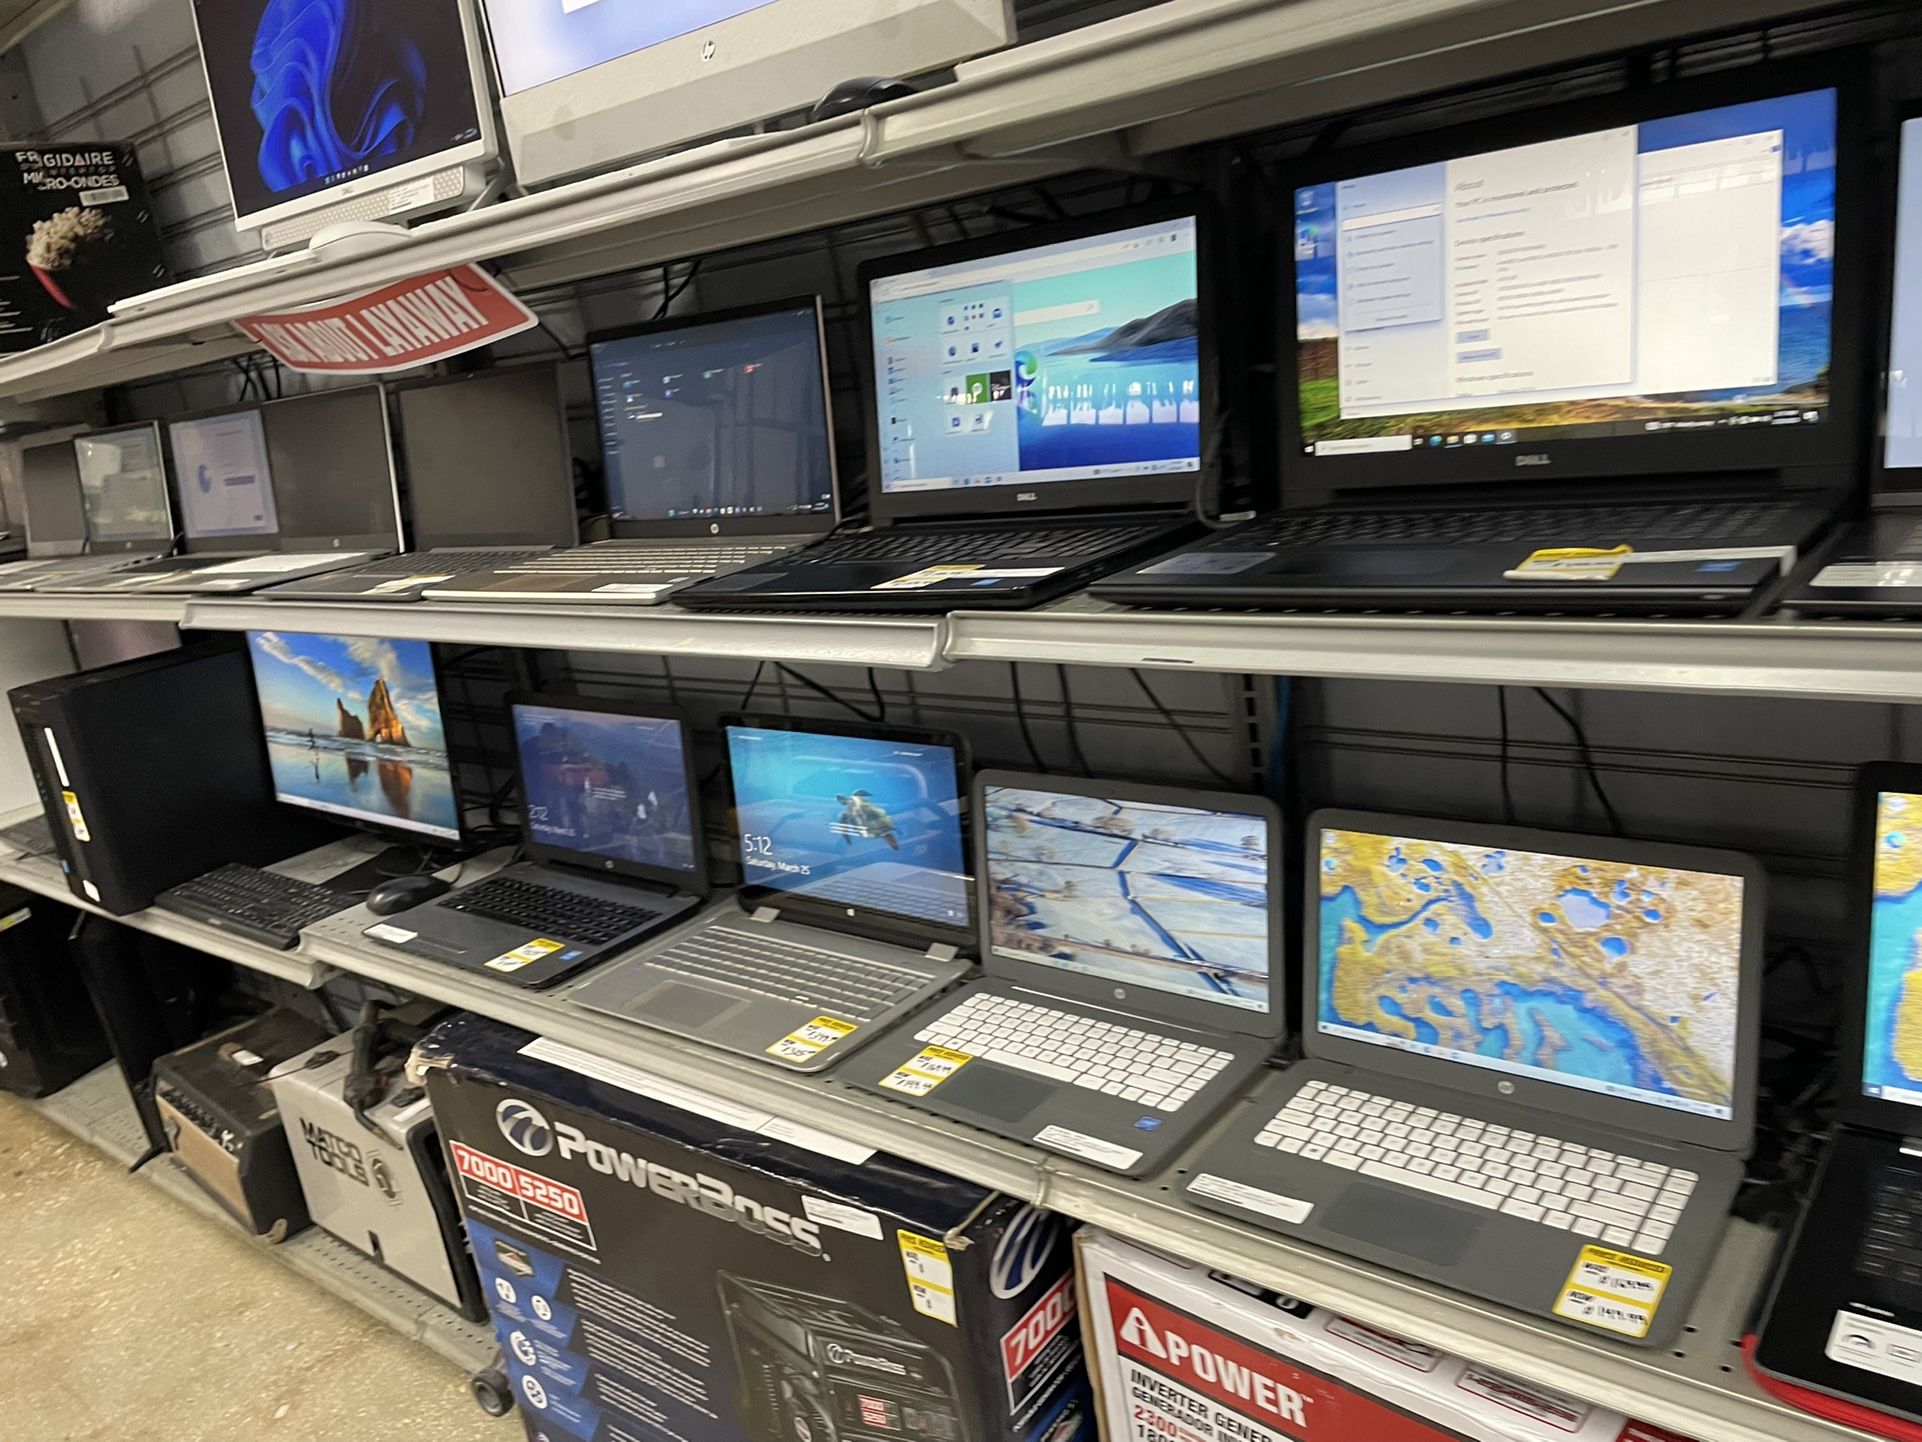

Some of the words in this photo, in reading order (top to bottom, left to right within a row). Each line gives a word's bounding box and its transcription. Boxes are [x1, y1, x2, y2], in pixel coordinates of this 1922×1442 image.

[345, 275, 489, 358] LAYAWAY
[743, 832, 773, 856] 5:12
[299, 1116, 363, 1165] MATCO
[456, 1148, 513, 1191] 7000
[518, 1174, 580, 1216] 5250
[1131, 1368, 1209, 1419] INVERTER
[1134, 1404, 1177, 1438] 2300
